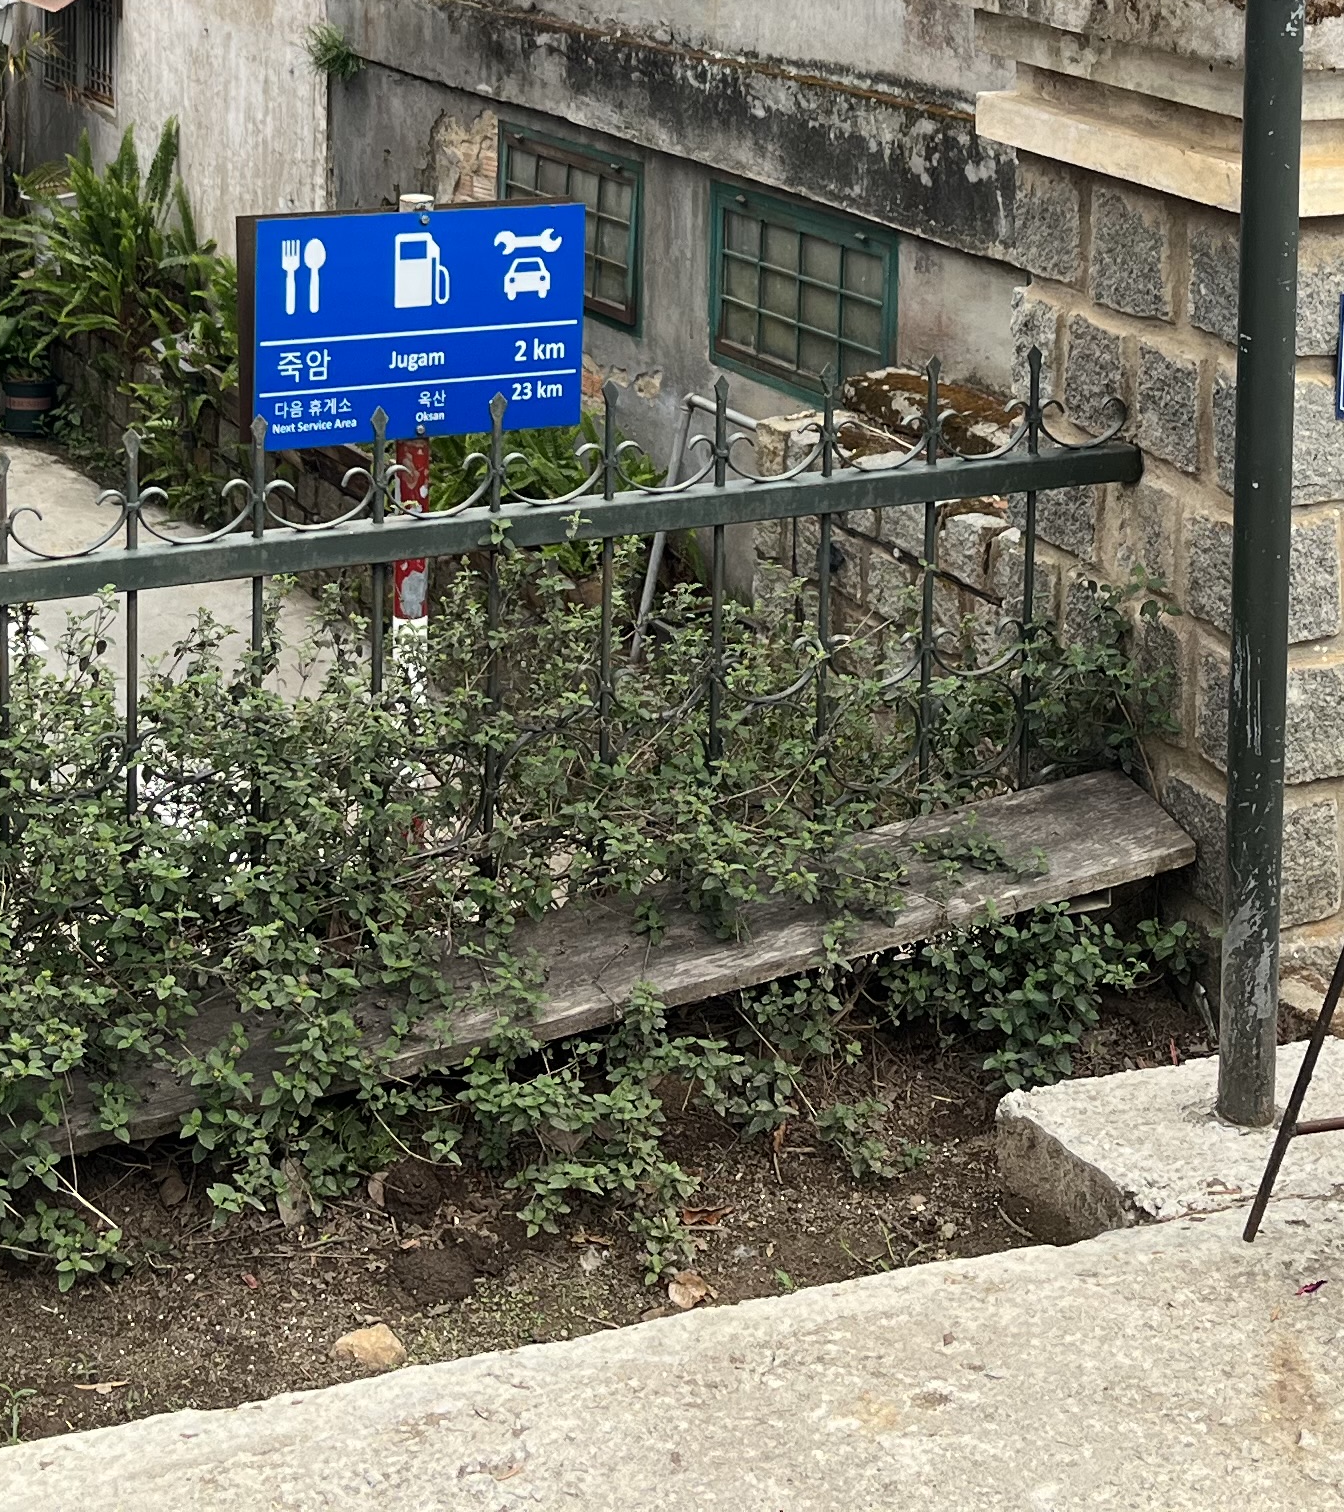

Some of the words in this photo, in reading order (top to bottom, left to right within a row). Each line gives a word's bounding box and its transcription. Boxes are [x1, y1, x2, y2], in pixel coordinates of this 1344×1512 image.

[514, 340, 527, 362] 2
[533, 338, 565, 361] km
[277, 348, 331, 383] 죽암
[388, 350, 445, 372] Jugam
[417, 389, 447, 408] 옥산
[511, 382, 533, 401] 23
[536, 380, 563, 399] km
[274, 400, 304, 419] 다음
[308, 396, 353, 416] 휴게소
[415, 410, 445, 424] Oksan
[272, 421, 296, 435] Next
[297, 419, 332, 433] Service
[334, 417, 357, 429] Area
